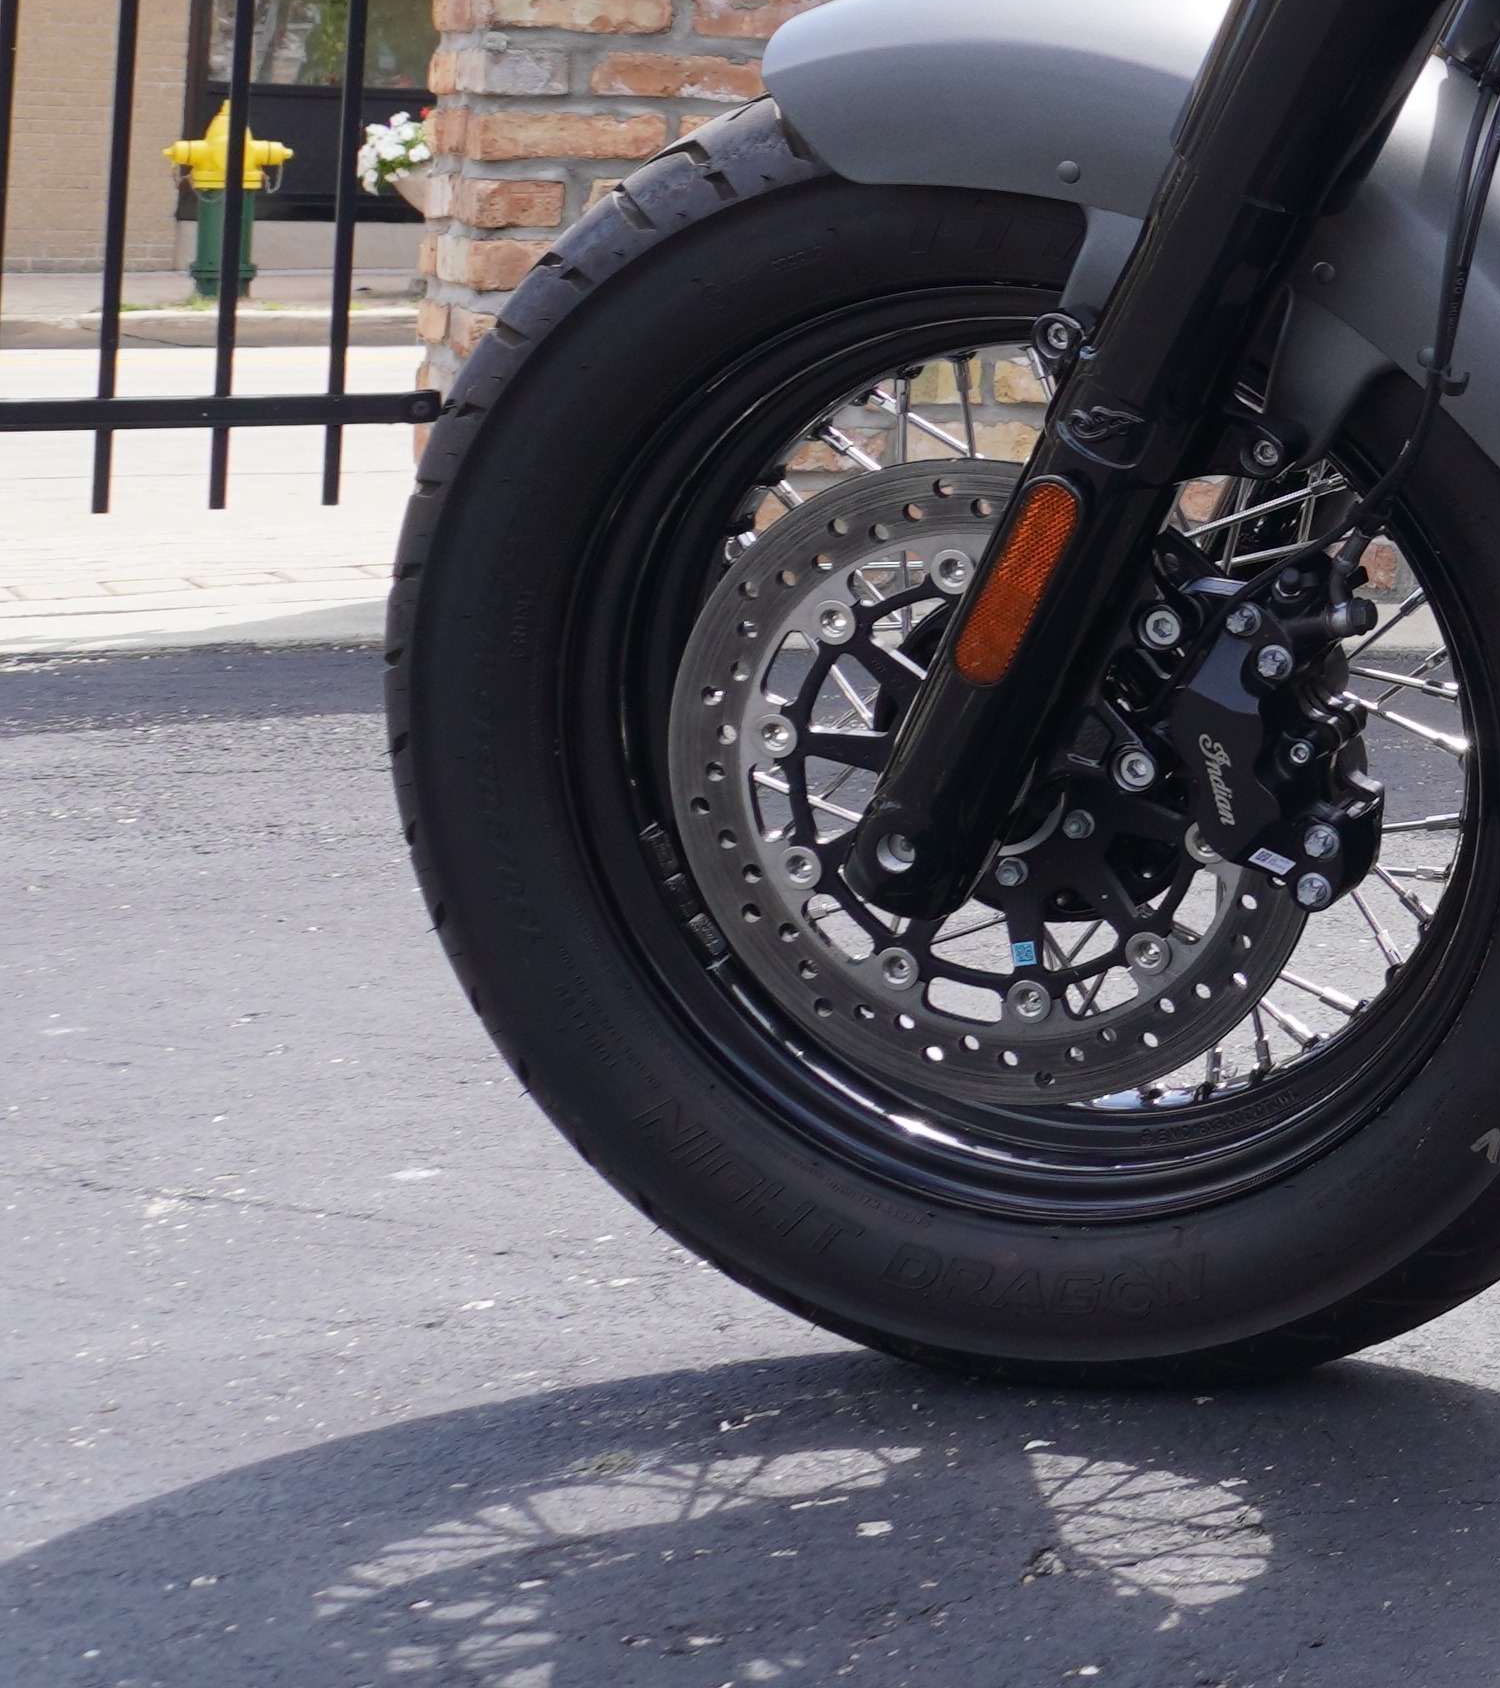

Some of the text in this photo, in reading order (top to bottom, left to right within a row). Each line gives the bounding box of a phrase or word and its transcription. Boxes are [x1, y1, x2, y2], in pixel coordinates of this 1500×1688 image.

[1197, 733, 1236, 826] Indian
[631, 1096, 1208, 1322] NIGHT DRAGON
